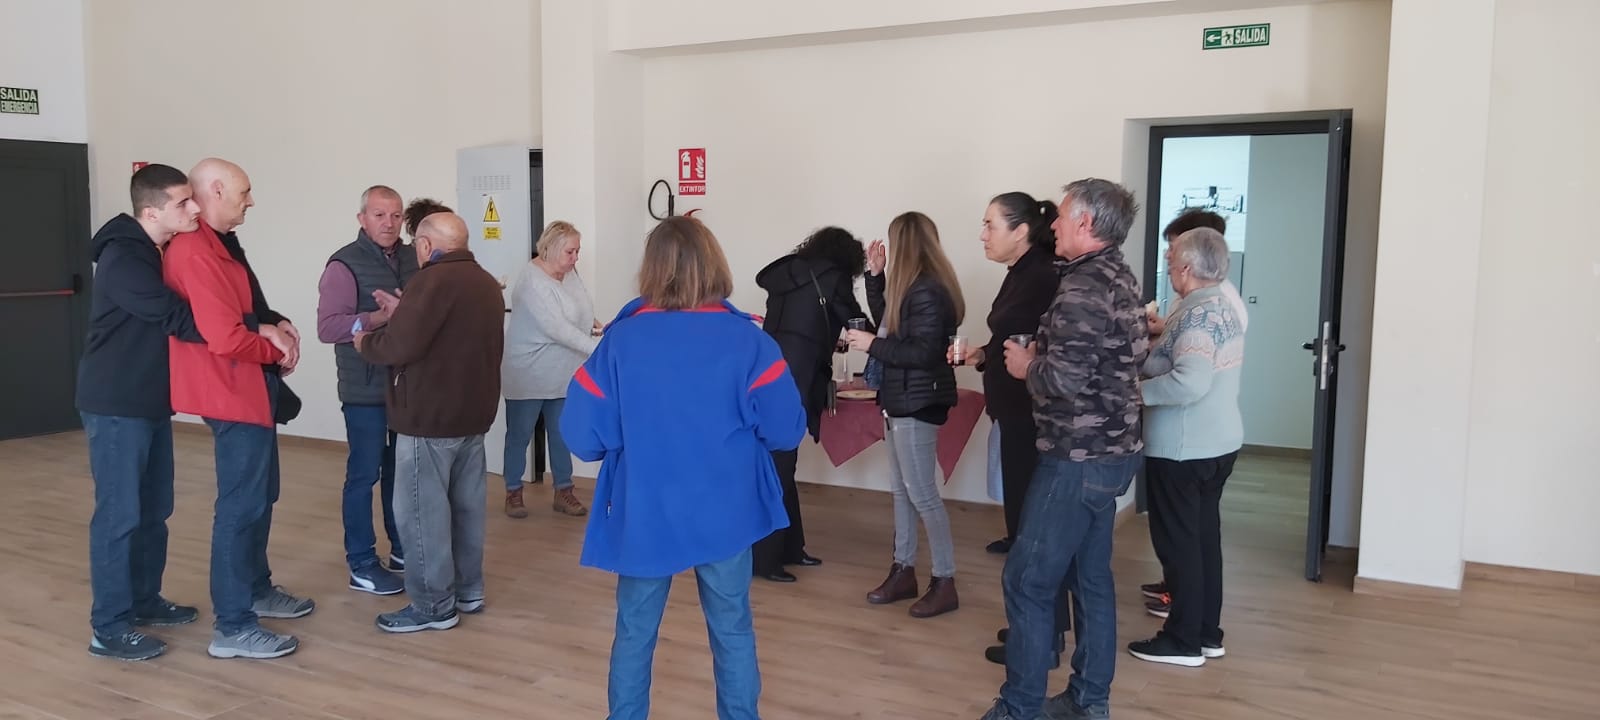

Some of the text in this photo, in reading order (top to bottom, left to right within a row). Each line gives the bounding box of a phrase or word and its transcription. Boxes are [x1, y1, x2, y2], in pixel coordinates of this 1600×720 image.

[1235, 27, 1266, 44] SALIDA
[0, 87, 37, 102] SALIDA
[1, 101, 38, 113] EMERGENCIA
[679, 185, 705, 193] EXTINTOR
